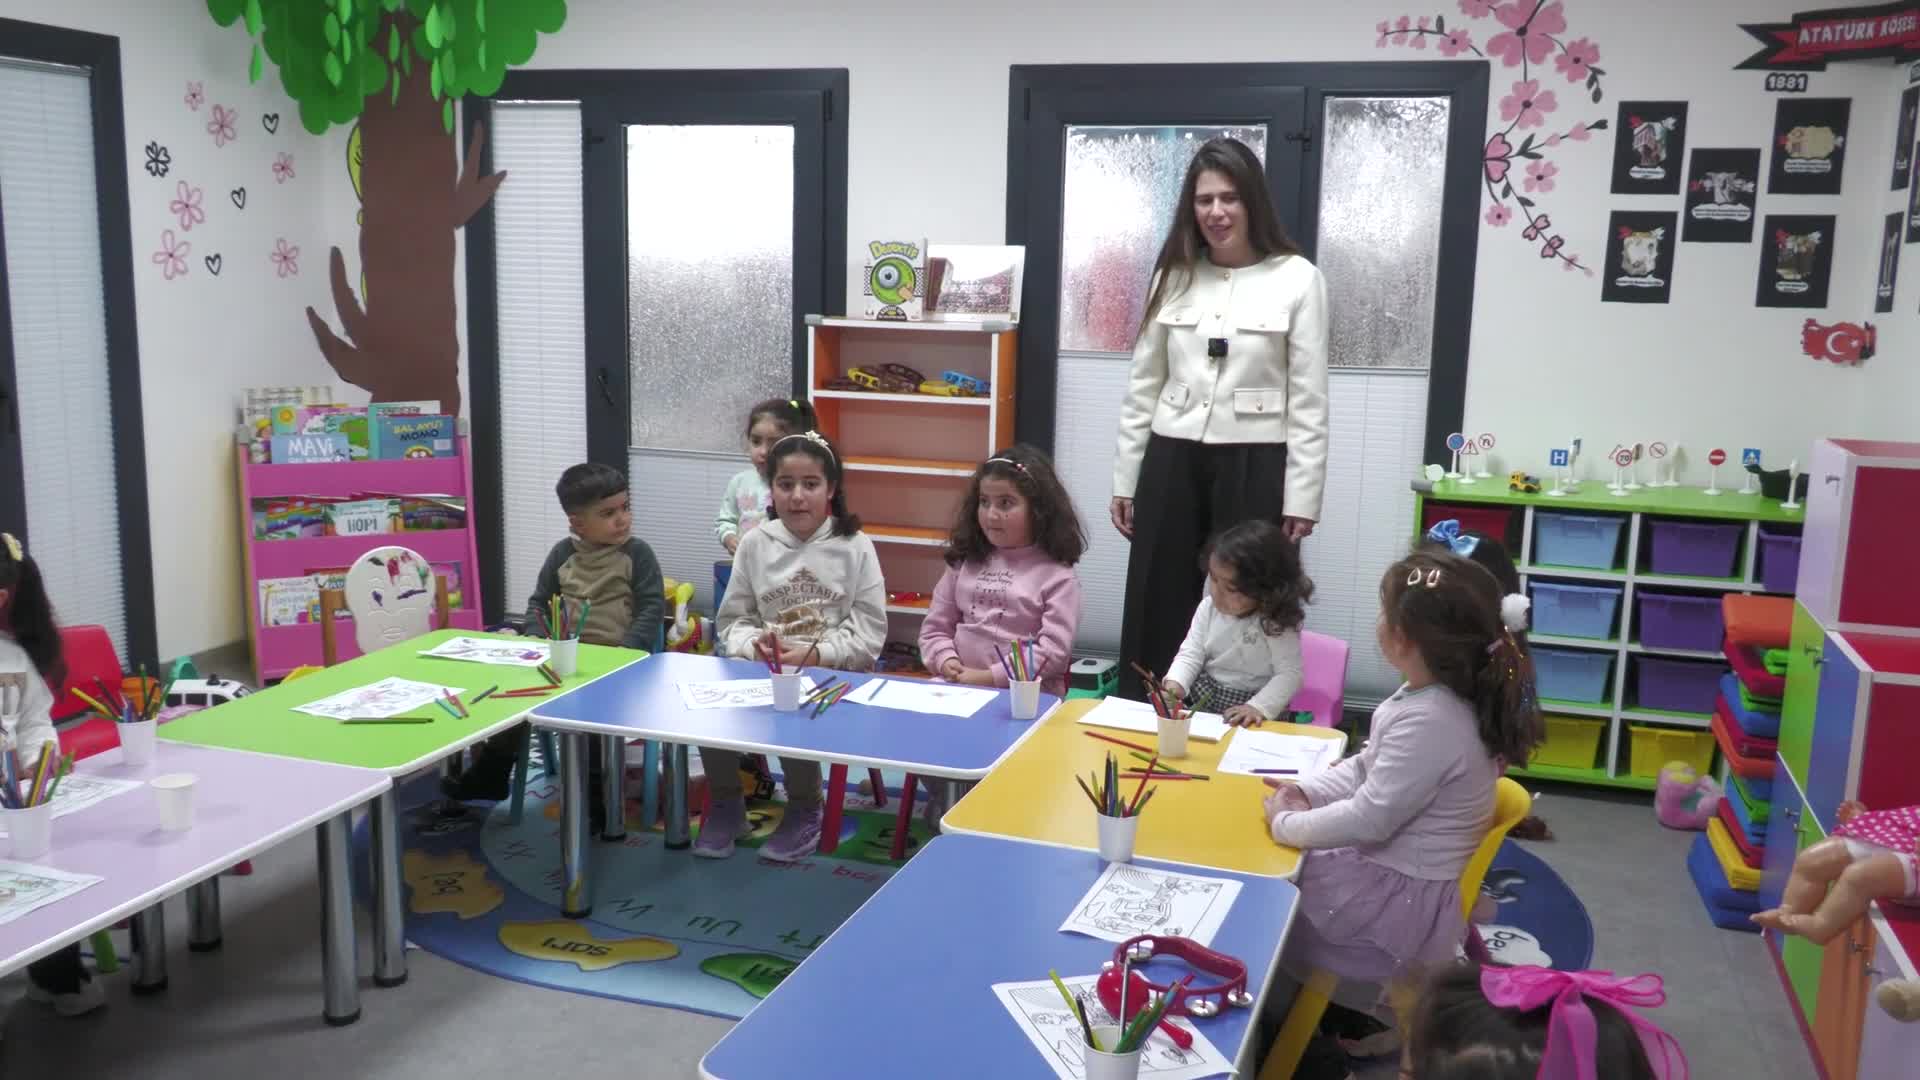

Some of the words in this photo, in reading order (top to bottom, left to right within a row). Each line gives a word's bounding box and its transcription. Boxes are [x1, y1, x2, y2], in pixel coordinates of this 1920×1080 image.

[1767, 74, 1806, 90] 1881
[401, 429, 440, 441] MOMO
[1554, 452, 1565, 465] H
